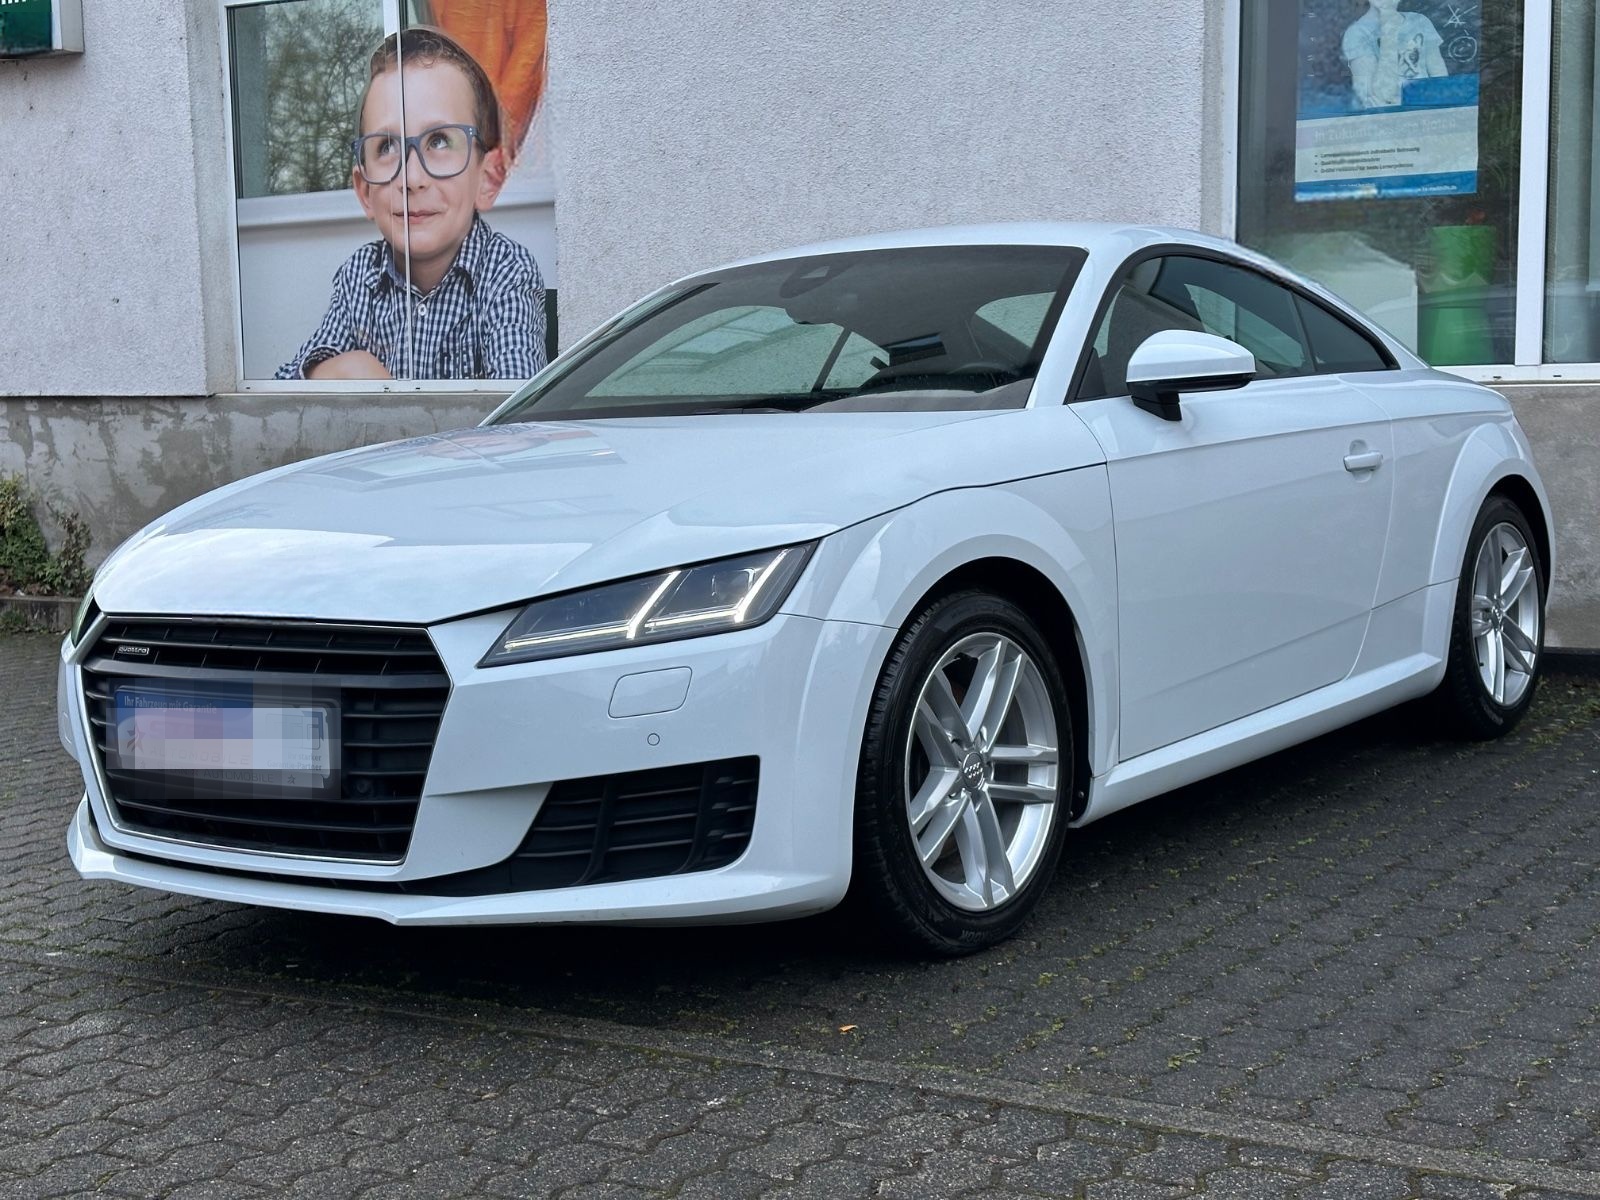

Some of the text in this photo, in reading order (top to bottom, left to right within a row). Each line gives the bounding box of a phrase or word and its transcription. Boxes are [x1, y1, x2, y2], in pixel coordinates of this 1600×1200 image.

[124, 695, 217, 714] Ihr Fahrzeug mit Garantie
